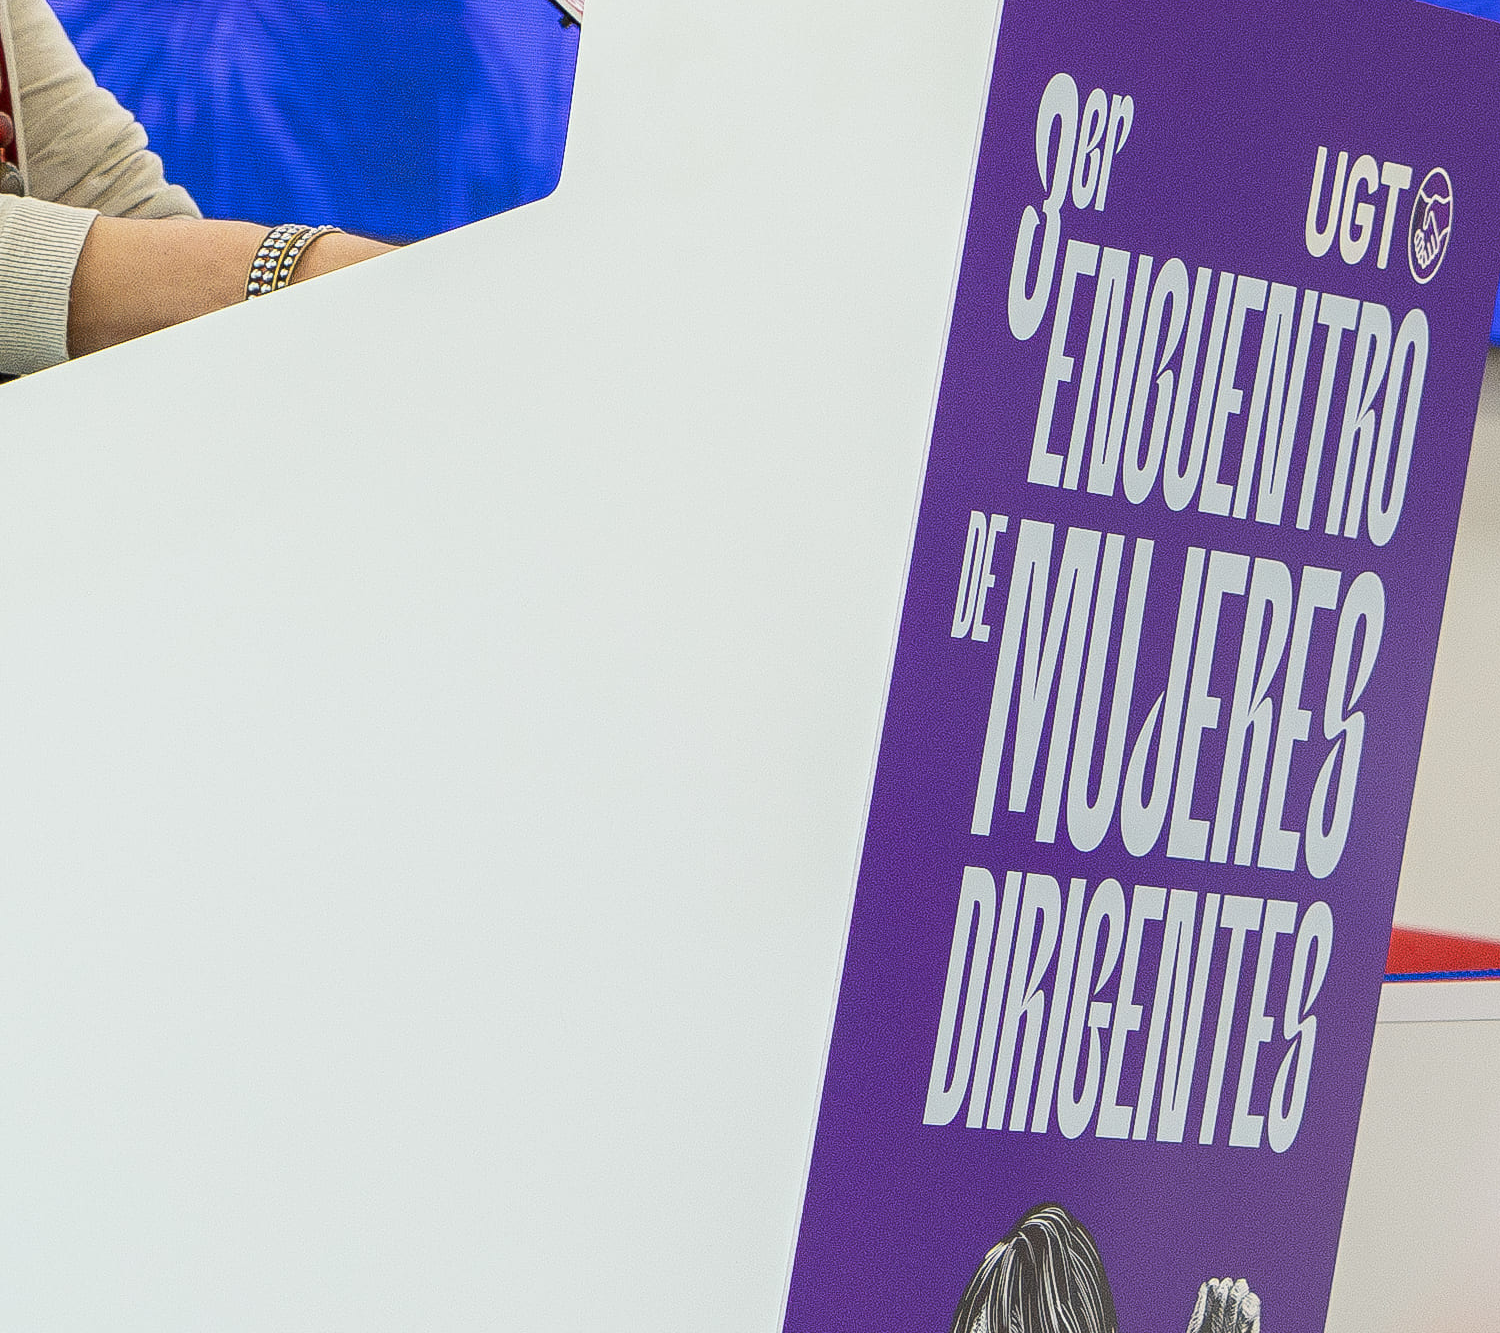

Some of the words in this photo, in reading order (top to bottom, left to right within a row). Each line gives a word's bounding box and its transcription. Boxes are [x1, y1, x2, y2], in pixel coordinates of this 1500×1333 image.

[1304, 145, 1413, 270] UGT
[1026, 239, 1431, 546] ENCUENTRO
[950, 511, 1008, 643] DE
[969, 519, 1388, 880] MUJERES
[922, 865, 1336, 1155] DIRIGENTES
